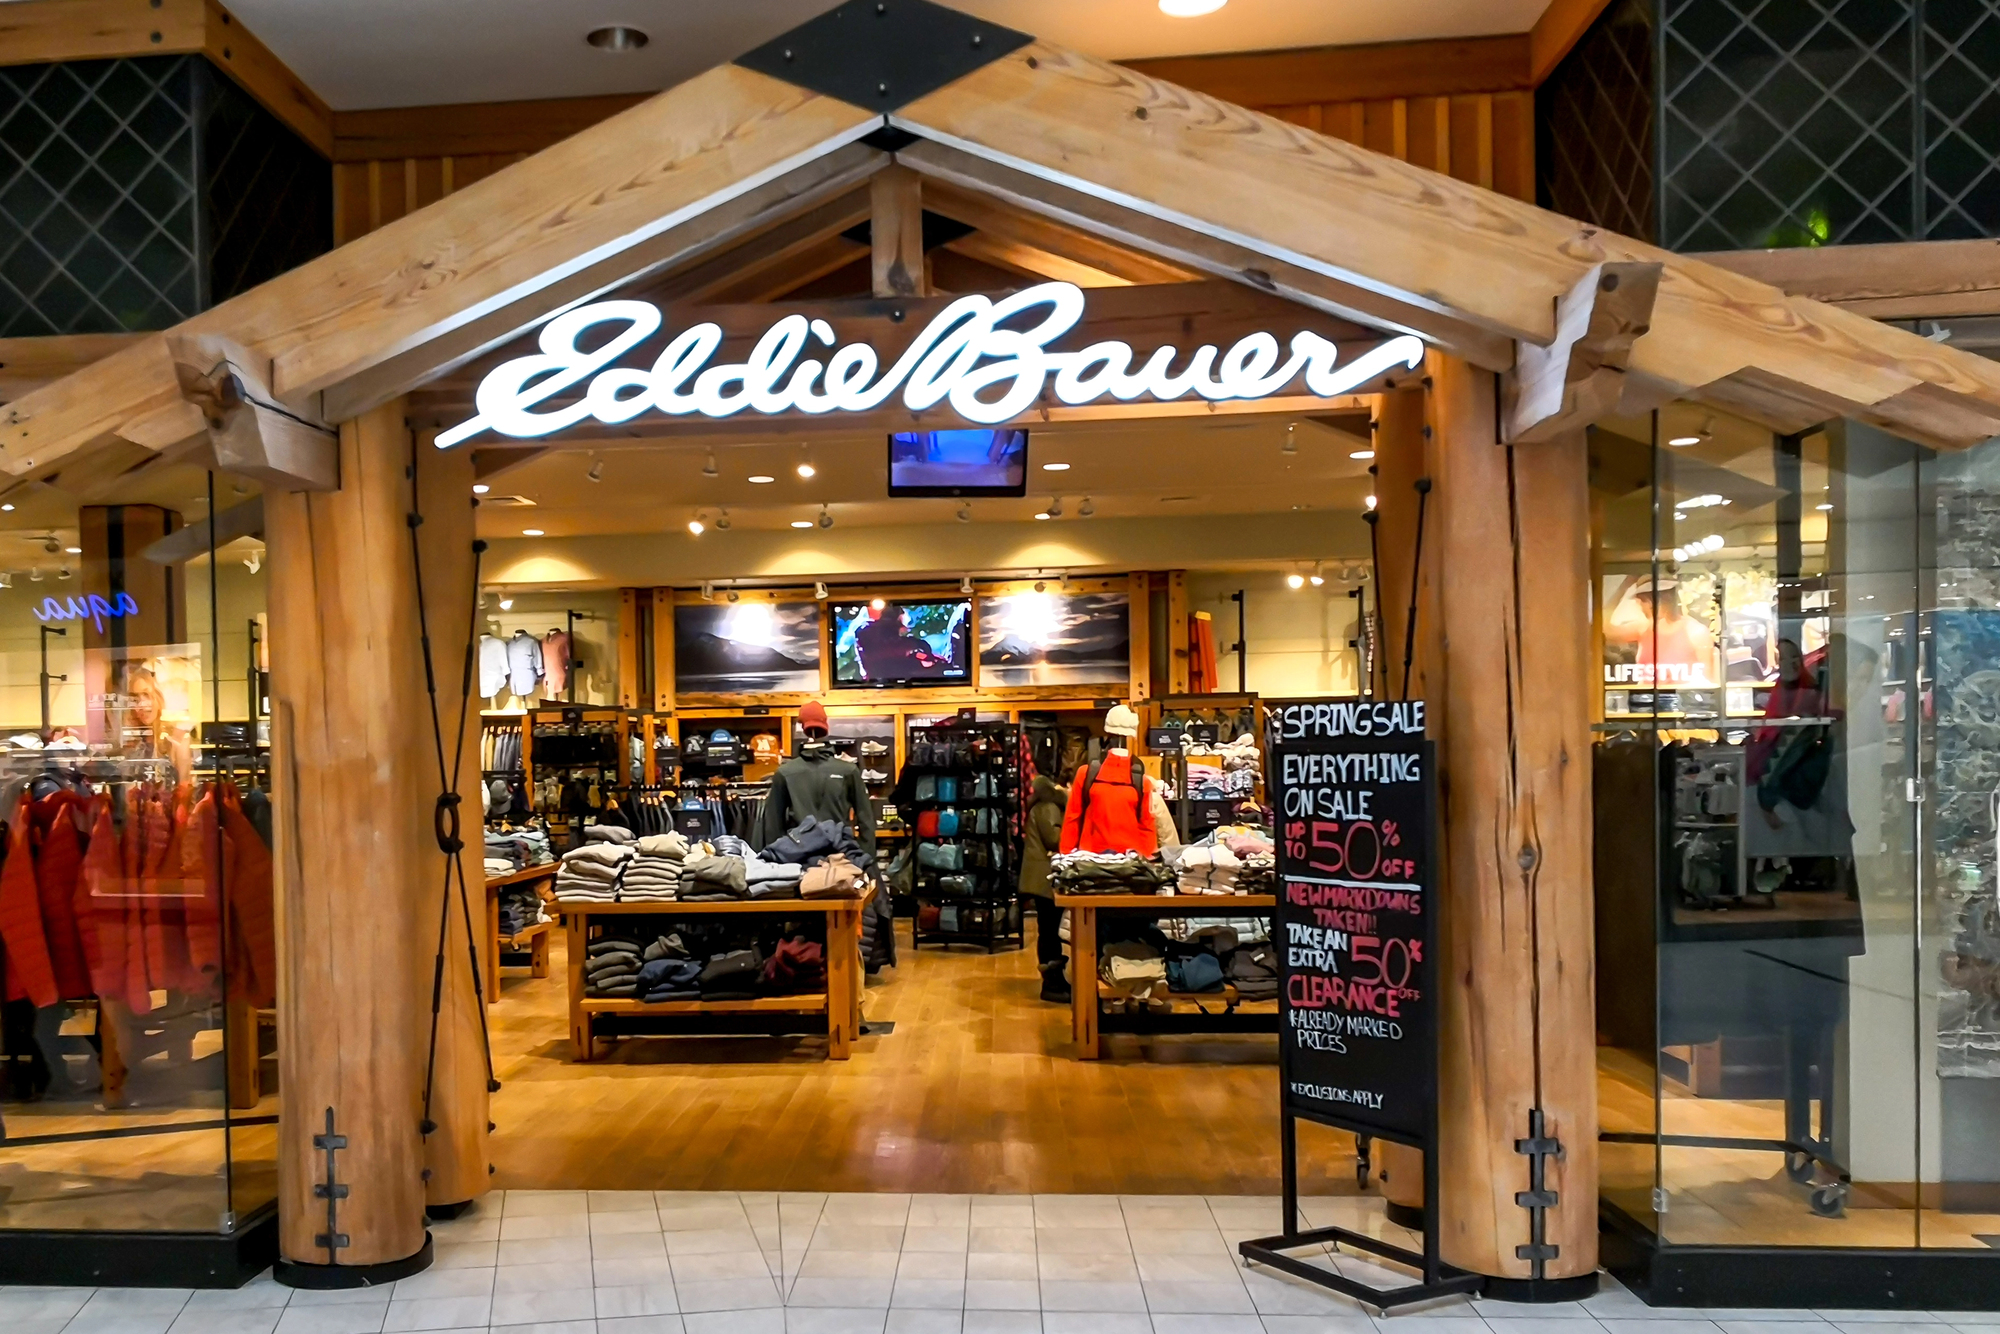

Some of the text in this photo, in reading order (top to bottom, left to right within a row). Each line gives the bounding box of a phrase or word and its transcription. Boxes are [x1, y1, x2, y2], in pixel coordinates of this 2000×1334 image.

[434, 281, 1424, 450] Eddie Bauer
[1604, 663, 1706, 682] LIFESTYLE
[1283, 701, 1425, 738] SPRING SALE
[1283, 753, 1421, 784] EVERYTHING
[1284, 787, 1374, 821] ON SALE
[1285, 821, 1306, 839] UP
[1285, 840, 1307, 859] TO
[1381, 858, 1416, 879] OFF
[1286, 882, 1421, 915] NEW MARKDOWNS
[1286, 923, 1348, 952] TAKE AN
[1287, 947, 1338, 973] EXTRA
[1287, 974, 1401, 1018] CLEARANCE
[1296, 1029, 1348, 1054] PRICES
[1347, 1015, 1404, 1040] MARKED
[1352, 1089, 1384, 1109] APPLY
